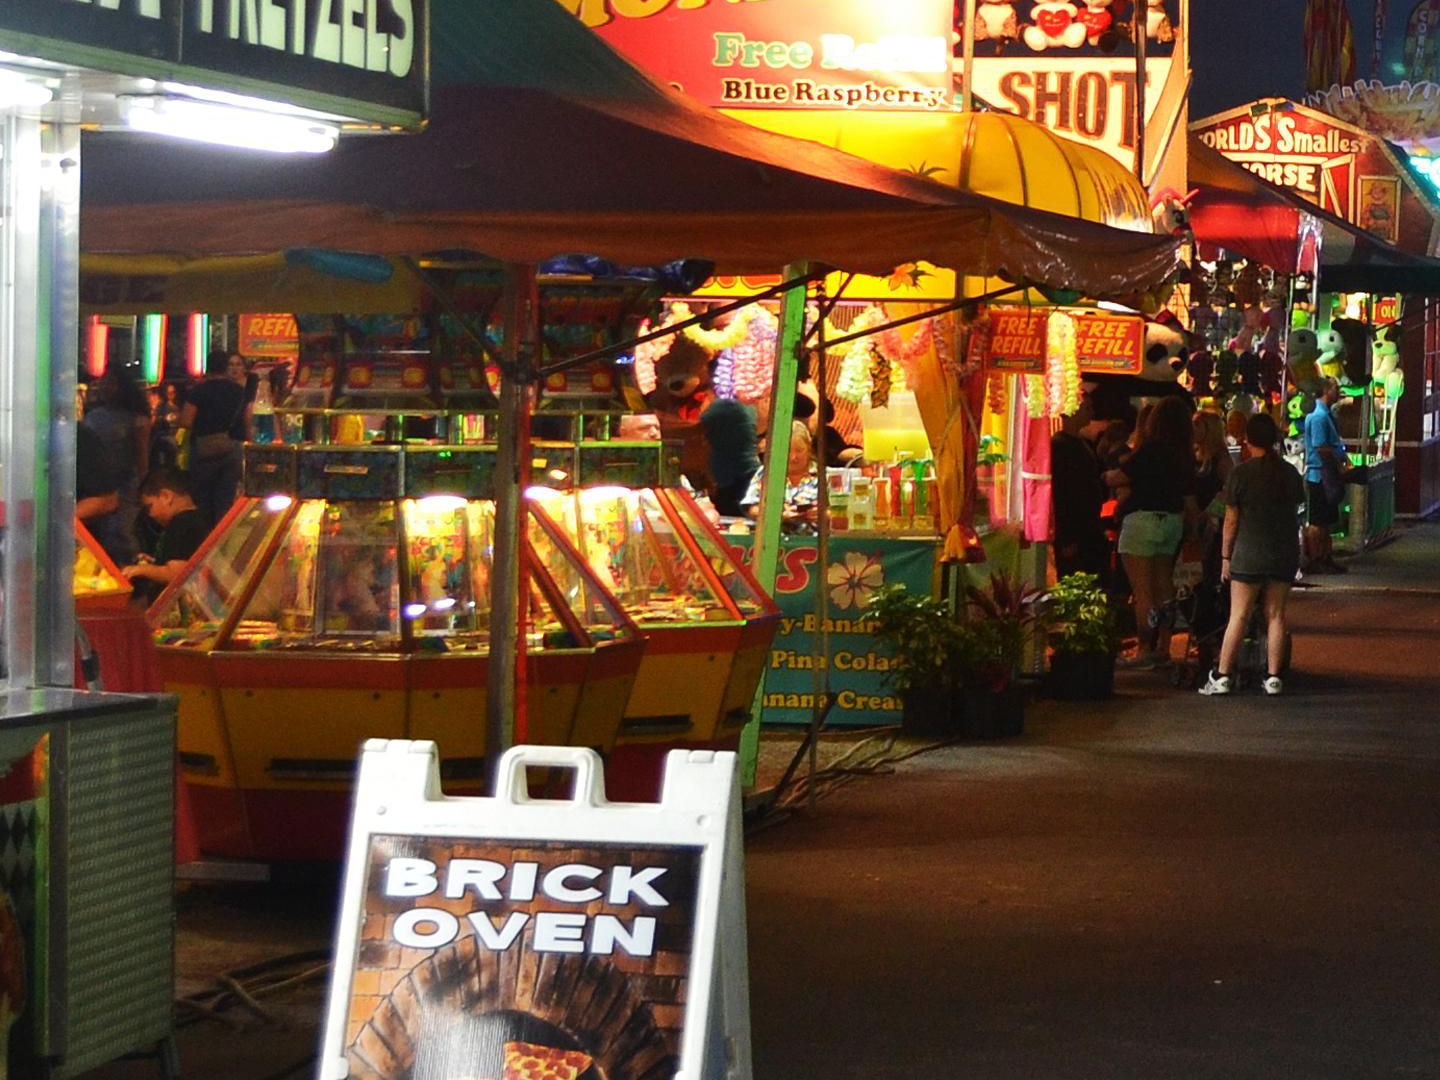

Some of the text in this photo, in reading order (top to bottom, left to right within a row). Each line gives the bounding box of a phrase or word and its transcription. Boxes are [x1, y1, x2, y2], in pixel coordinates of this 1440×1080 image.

[713, 32, 813, 67] Free
[723, 79, 944, 107] Blue Raspberry
[998, 70, 1151, 150] SHOT
[1277, 116, 1369, 154] Smallest
[1241, 162, 1316, 193] ORSE
[997, 316, 1038, 335] FREE
[1079, 320, 1132, 338] FREE
[991, 336, 1042, 355] REFILL
[385, 857, 670, 907] BRICK
[392, 907, 657, 957] OVEN
